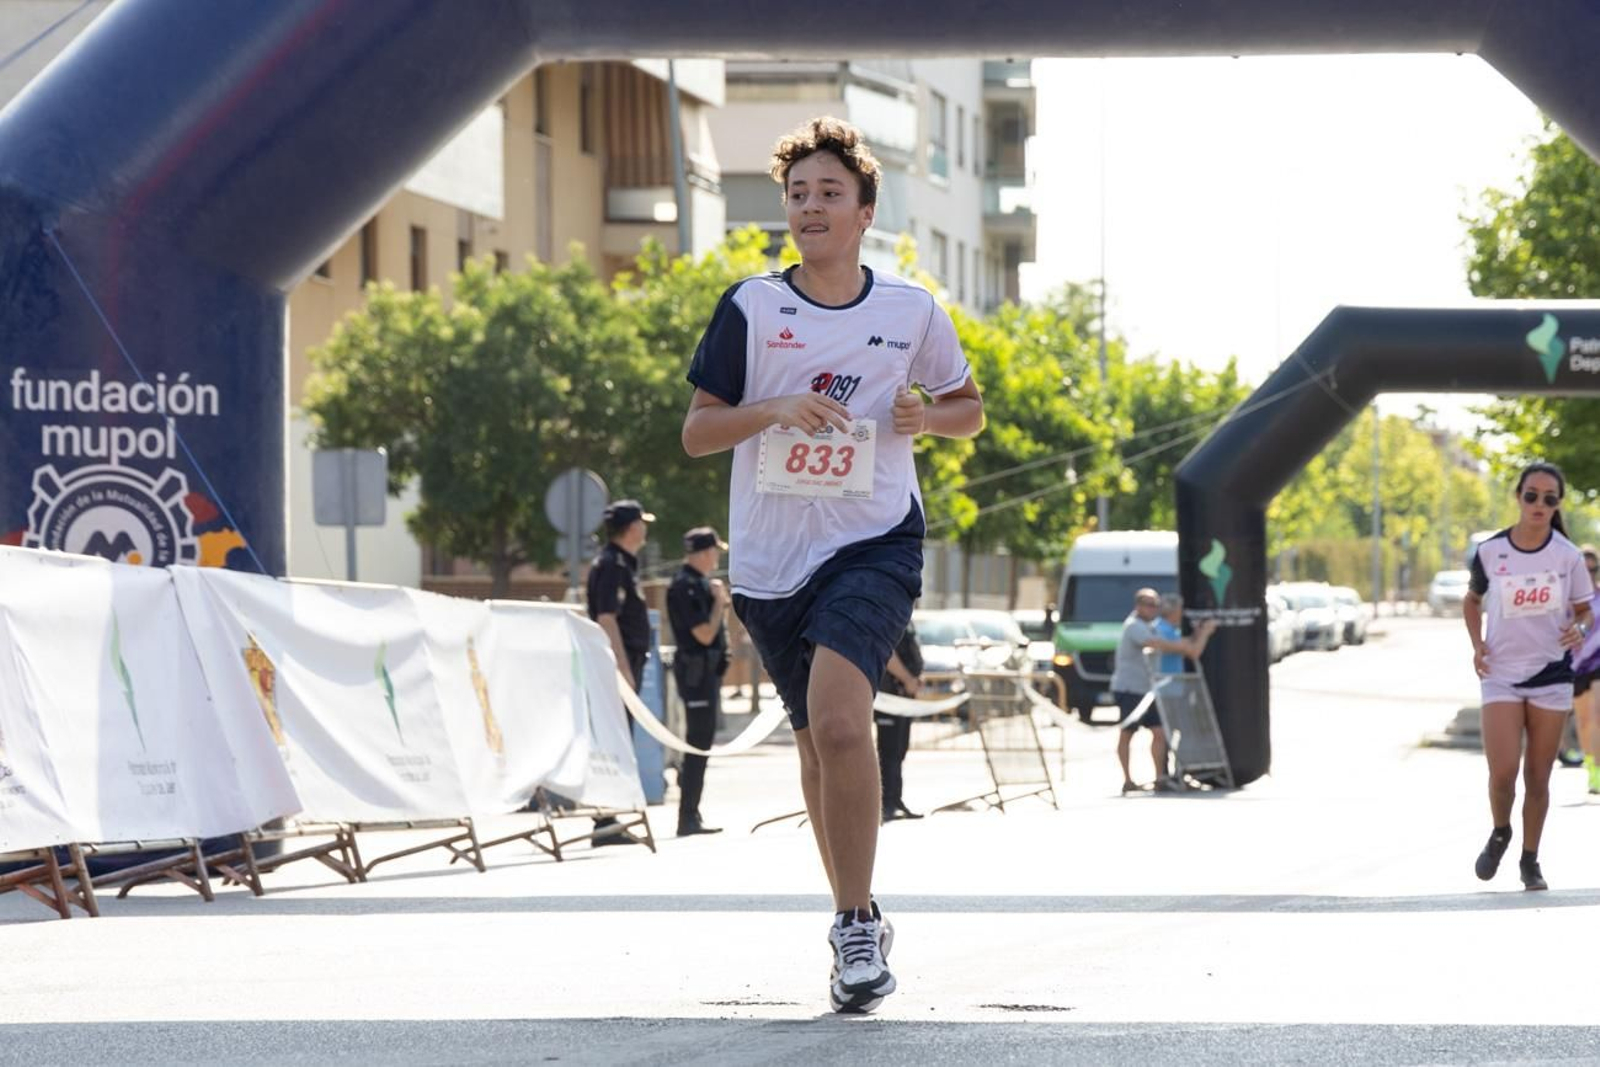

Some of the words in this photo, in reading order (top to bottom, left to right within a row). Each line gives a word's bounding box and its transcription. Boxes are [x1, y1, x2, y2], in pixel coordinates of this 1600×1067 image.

[767, 340, 807, 349] Santander
[10, 367, 219, 416] fundación
[42, 417, 175, 465] mupol
[785, 442, 855, 477] 833
[91, 489, 104, 500] la
[1513, 586, 1550, 606] 846
